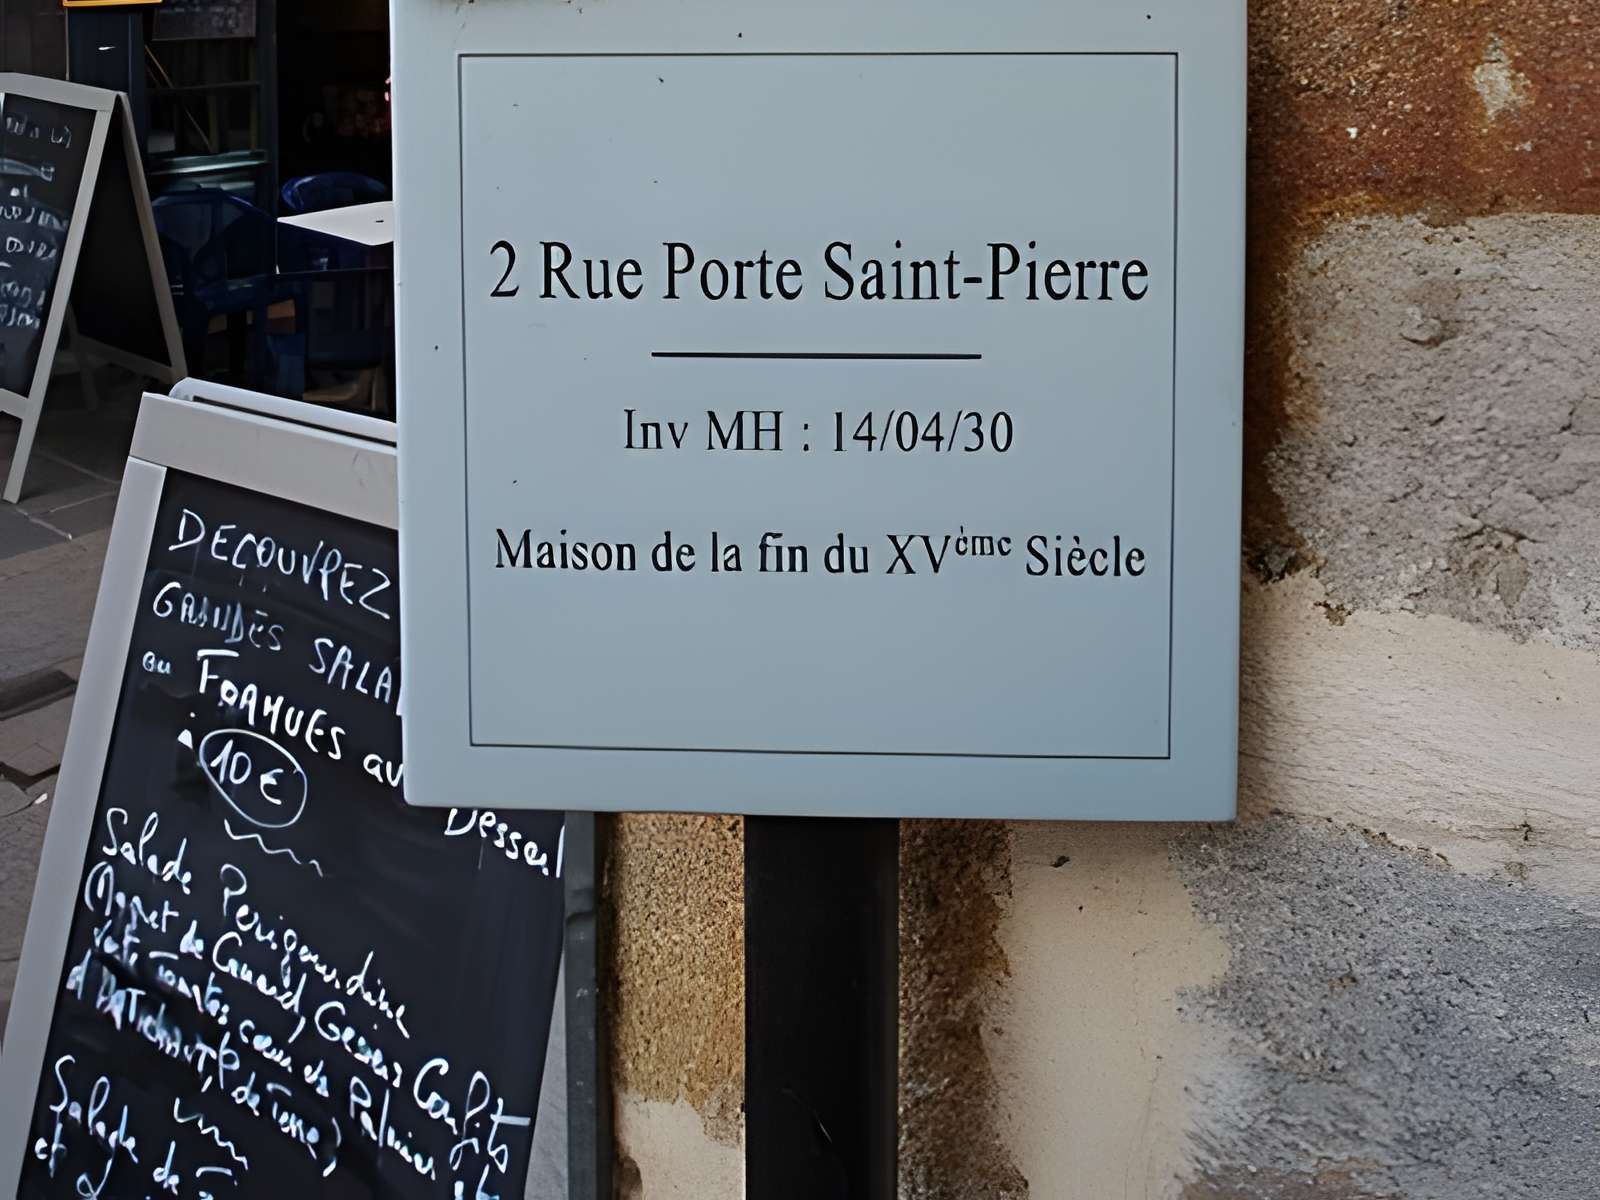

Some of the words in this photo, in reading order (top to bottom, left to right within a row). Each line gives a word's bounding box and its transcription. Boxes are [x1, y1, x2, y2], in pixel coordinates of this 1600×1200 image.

[489, 240, 520, 299] 2
[539, 240, 645, 301] Rue
[661, 241, 804, 302] Porte
[823, 239, 1150, 302] Saint-Pierre
[622, 408, 690, 451] Inv
[705, 410, 784, 452] MH
[833, 409, 1014, 453] 14/04/30
[494, 528, 637, 572] Maison
[650, 530, 696, 572] de
[710, 531, 743, 573] la
[757, 531, 809, 574] fin
[823, 532, 870, 575] du
[1025, 534, 1147, 578] Siècle
[308, 637, 402, 716] SALA
[362, 752, 403, 788] av
